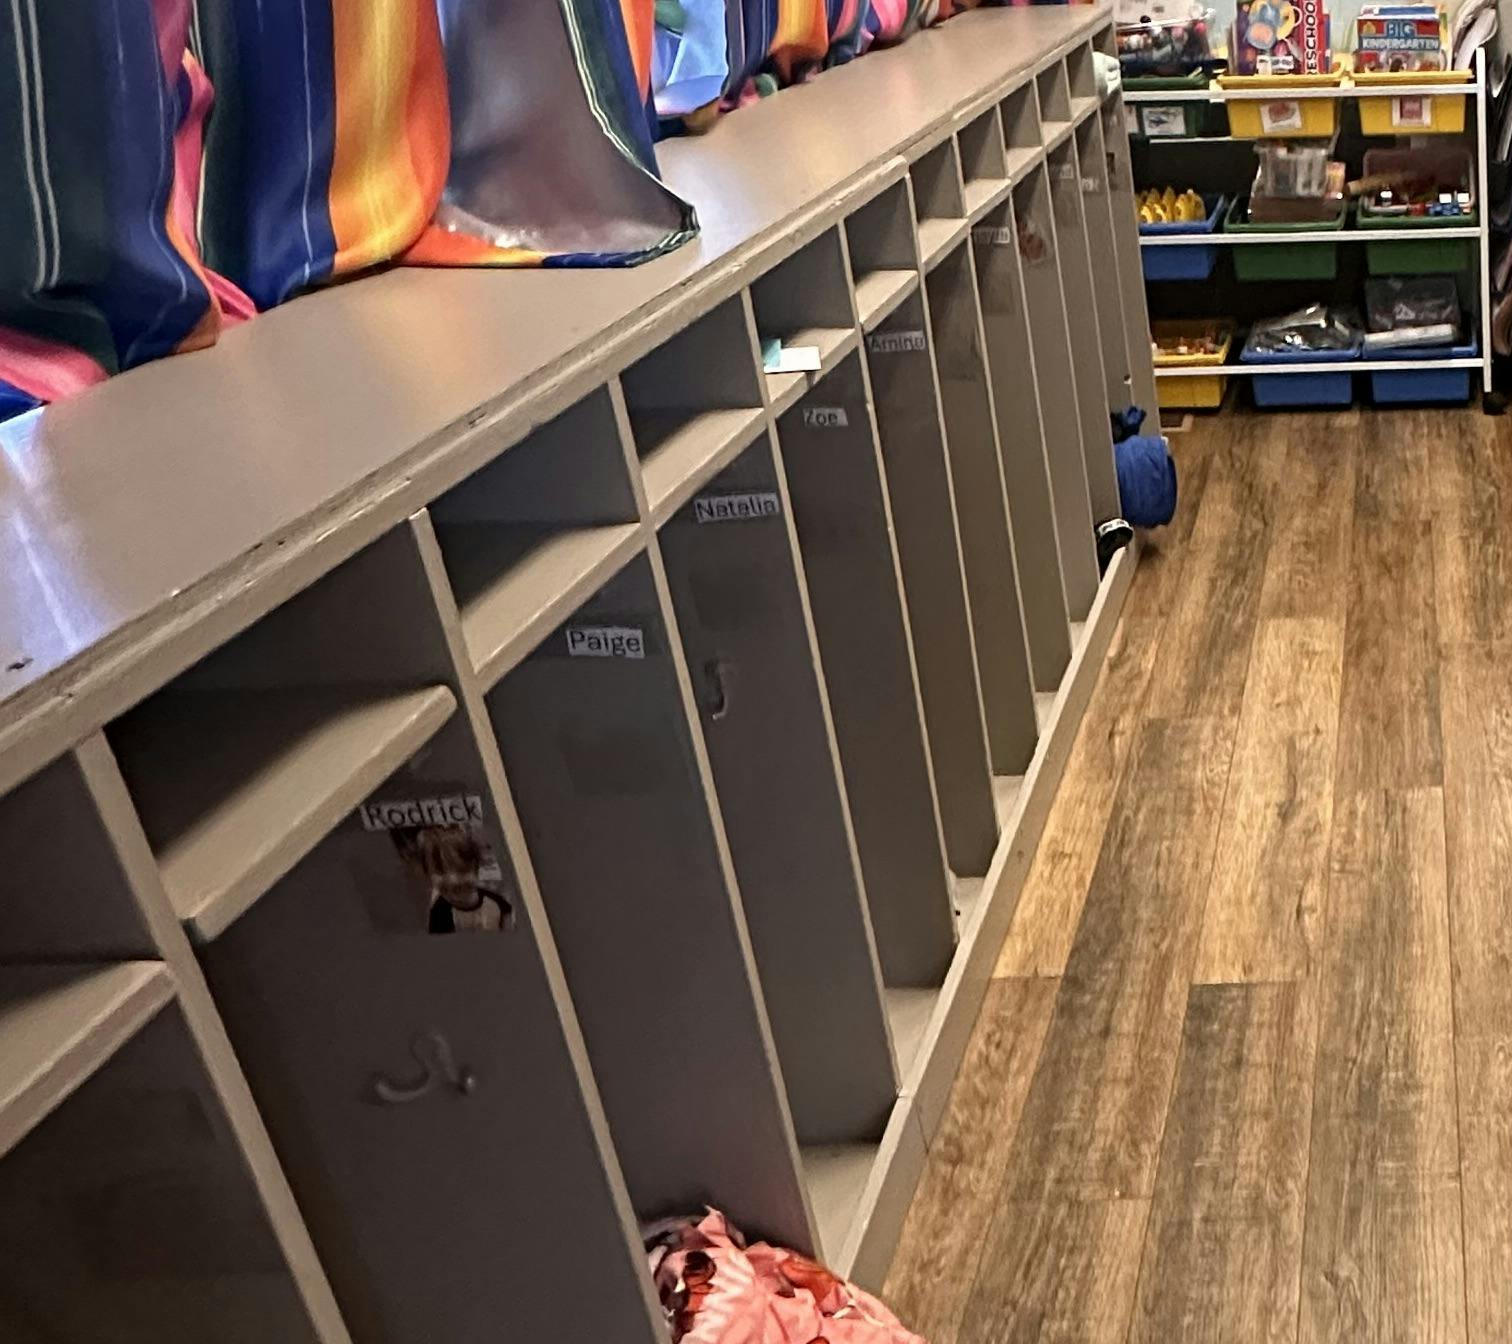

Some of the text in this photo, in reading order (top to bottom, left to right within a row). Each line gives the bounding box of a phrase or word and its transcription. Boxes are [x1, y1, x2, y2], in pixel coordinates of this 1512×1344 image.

[1387, 21, 1416, 36] BIG
[1362, 37, 1439, 50] KINDERGARTEN
[696, 496, 776, 518] Natalia
[569, 630, 641, 657] Paige
[365, 793, 482, 827] Rodrick
